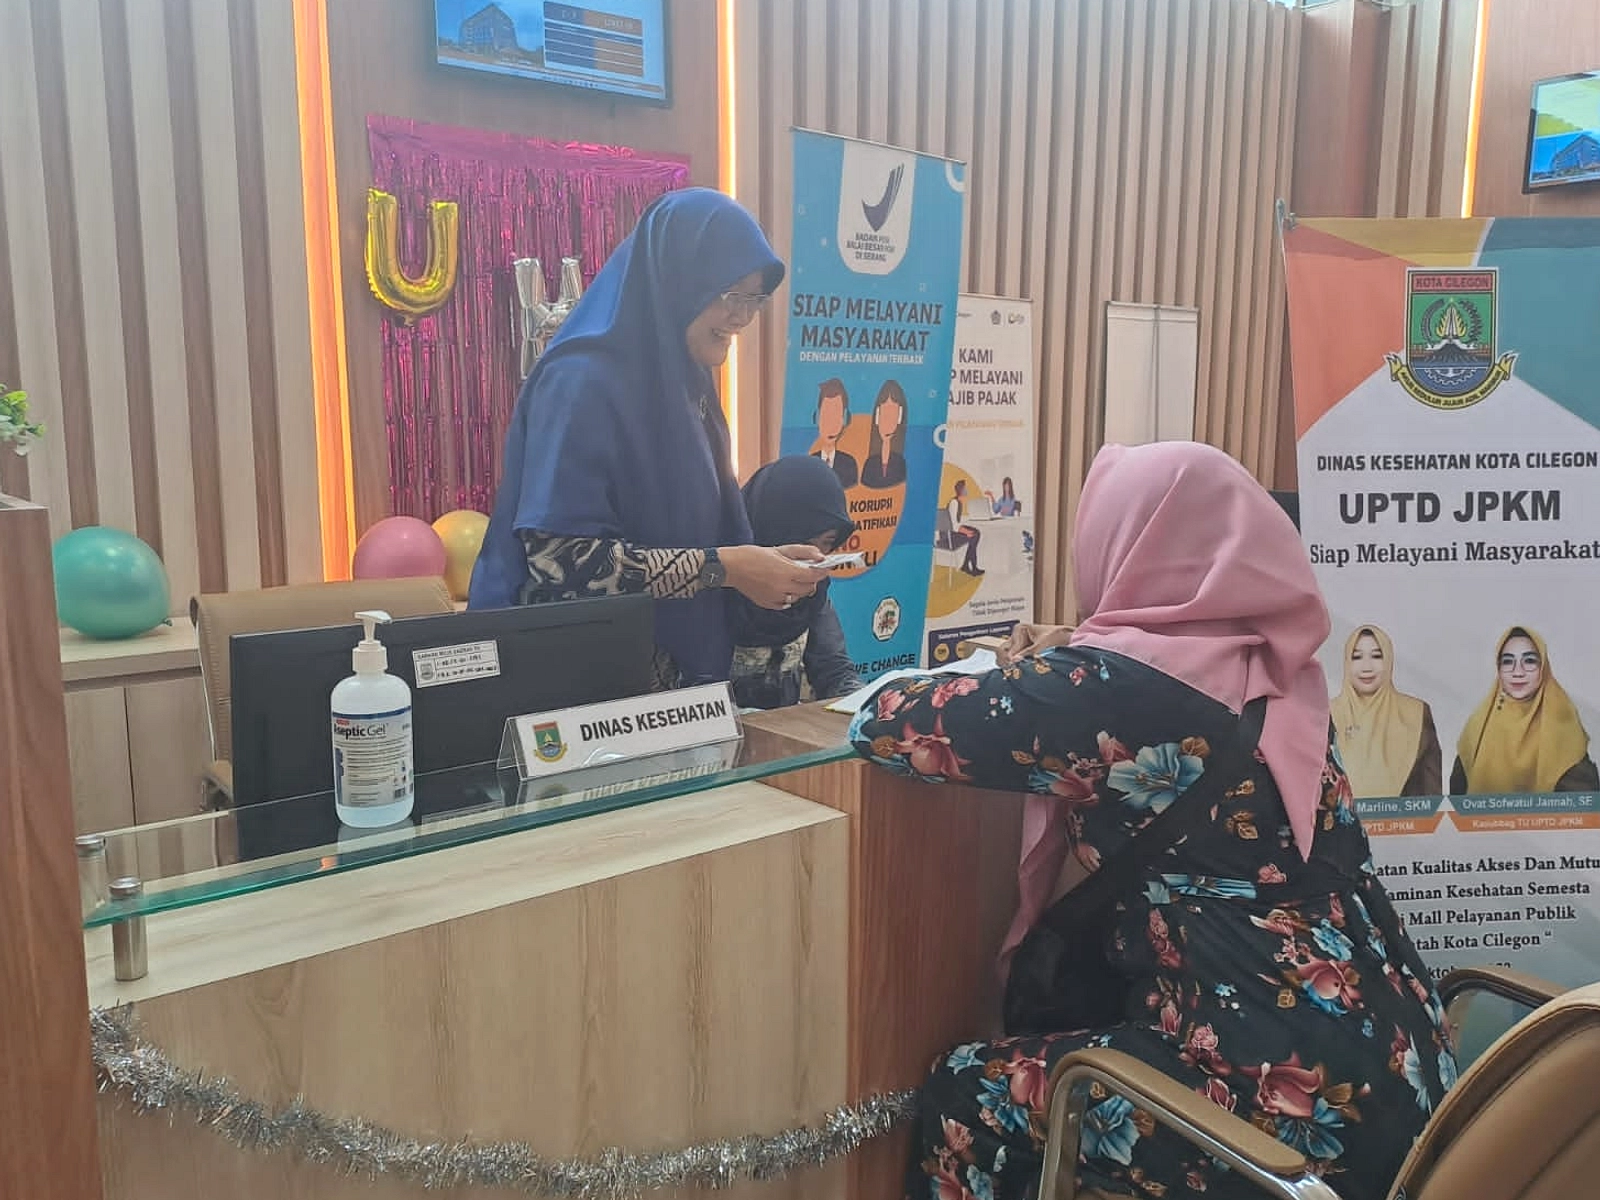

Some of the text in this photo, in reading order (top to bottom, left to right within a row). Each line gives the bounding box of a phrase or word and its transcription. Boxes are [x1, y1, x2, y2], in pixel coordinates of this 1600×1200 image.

[1415, 276, 1489, 288] KOTA CILEGON
[793, 293, 943, 325] SIAP MELAYANI
[801, 324, 930, 351] MASYARAKAT
[800, 351, 837, 363] DENGAN
[838, 352, 888, 364] PELAYANAN
[958, 348, 993, 364] KAMI
[959, 370, 1023, 385] MELAYANI
[949, 390, 1017, 406] AJIB PAJAK
[1317, 452, 1598, 471] DINAS KESEHATAN KOTA CILEGON
[1339, 490, 1561, 524] UPTD JPKM
[855, 515, 898, 531] ATIFIKASI
[1310, 540, 1600, 567] Siap Melayani Masyarakat
[871, 653, 915, 672] CHANGE
[580, 699, 727, 741] DINAS KESEHATAN
[367, 723, 386, 736] Gel
[1404, 799, 1431, 811] SKM
[1463, 798, 1486, 809] Ovat
[1488, 797, 1533, 809] Sofwatul
[1578, 795, 1593, 806] SE
[1387, 820, 1416, 832] JPKM
[1376, 855, 1600, 877] atan Kualitas Akses Dan Mutu
[1446, 883, 1523, 899] Kesehatan
[1527, 881, 1591, 896] Semesta
[1409, 909, 1442, 925] Mall
[1446, 907, 1521, 925] Pelayanan
[1526, 905, 1576, 920] Publik
[1416, 937, 1439, 950] tah
[1443, 934, 1478, 949] Kota
[1483, 933, 1541, 949] Cilegon
